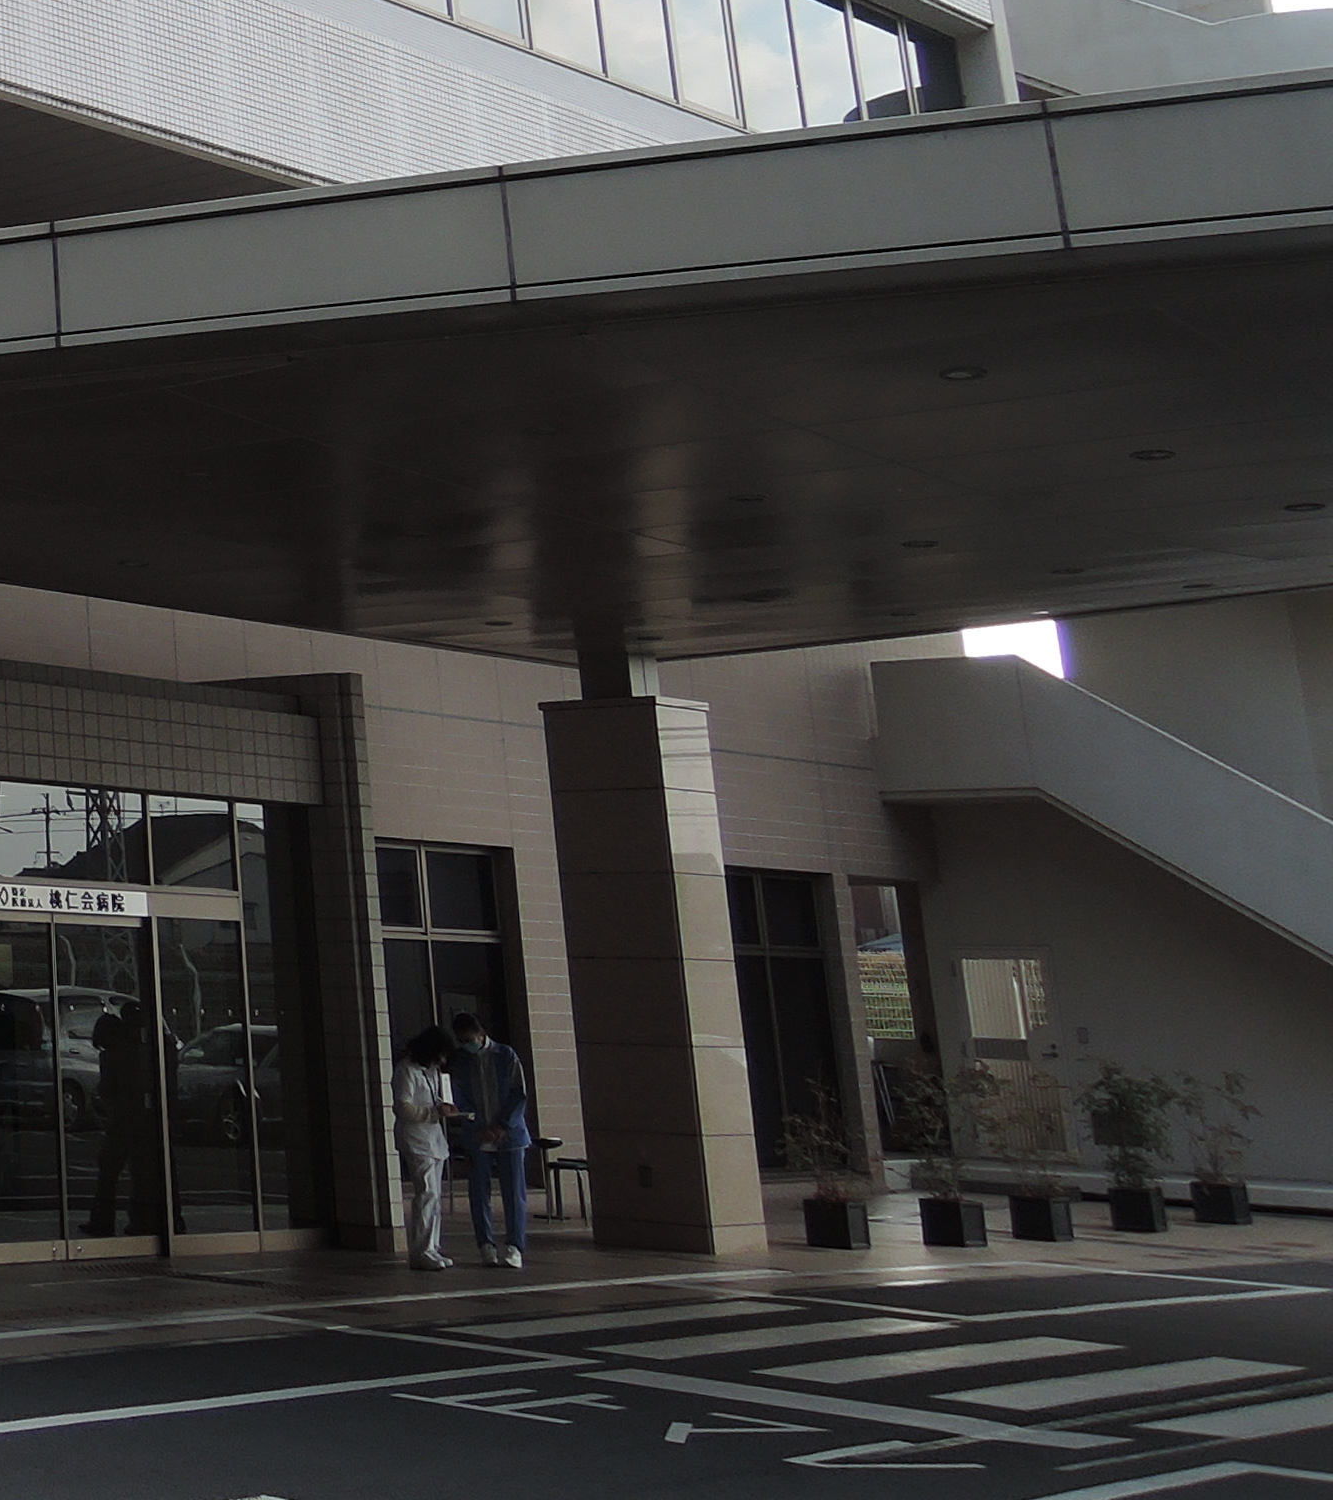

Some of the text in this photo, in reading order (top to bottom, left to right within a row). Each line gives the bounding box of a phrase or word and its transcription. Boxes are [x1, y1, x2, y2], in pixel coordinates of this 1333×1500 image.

[49, 889, 125, 912] 桃仁会病院
